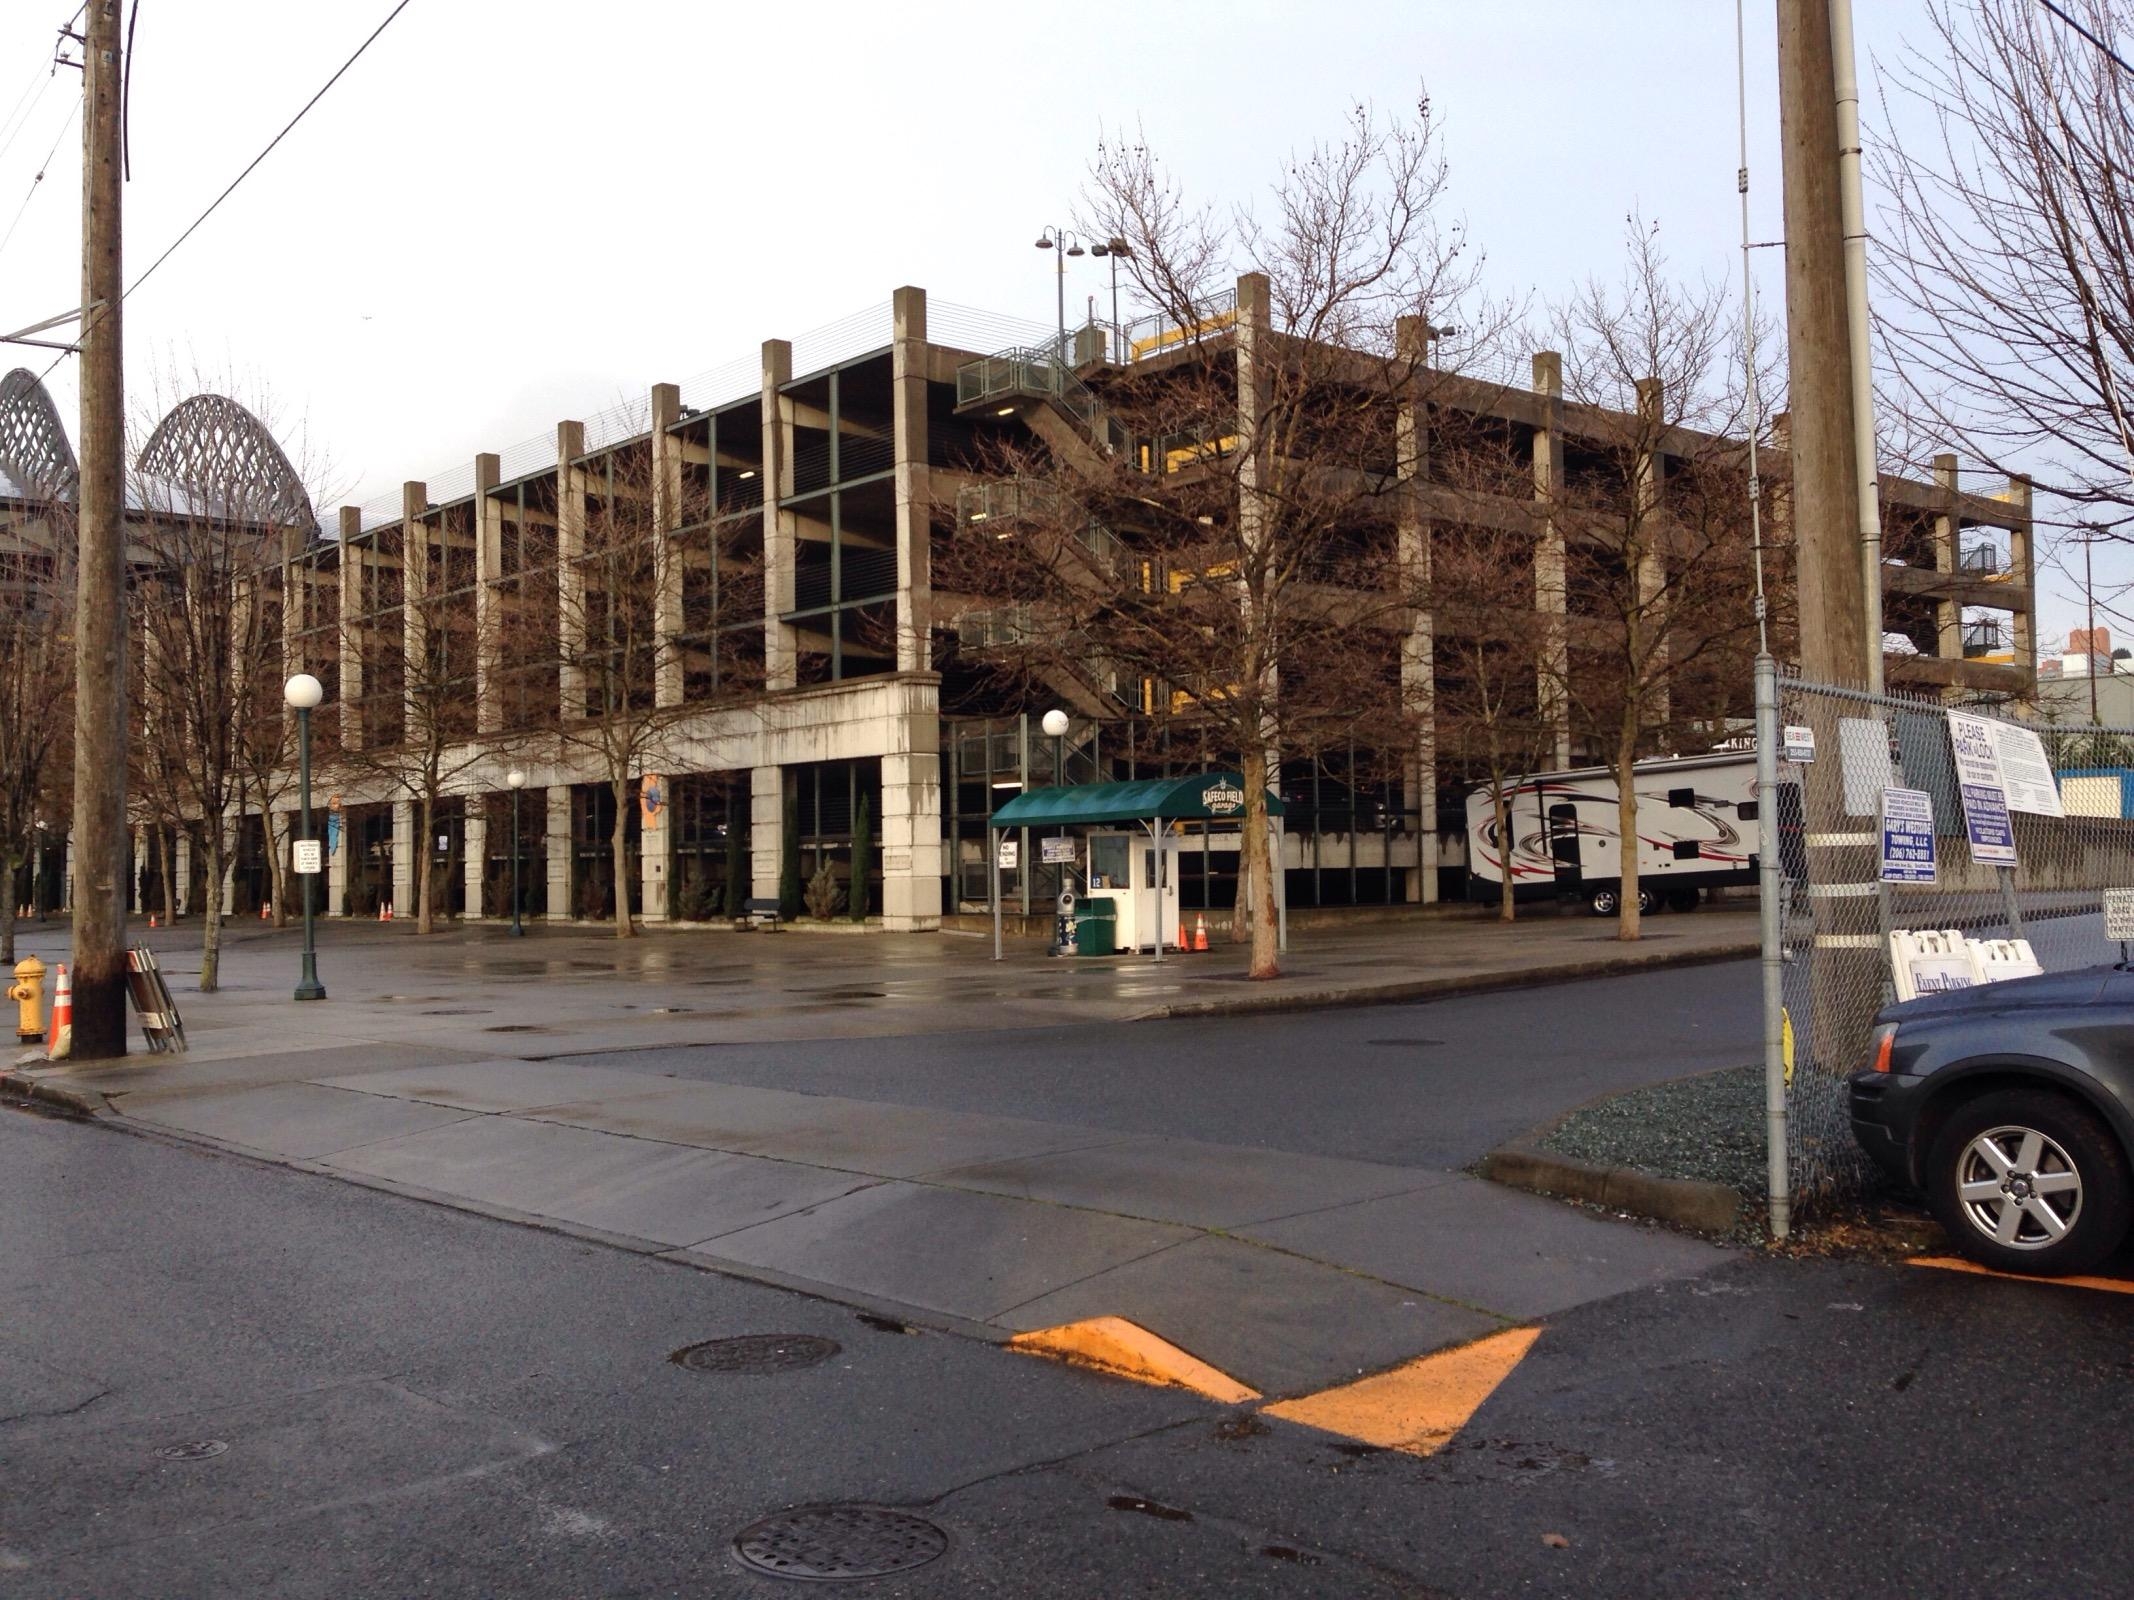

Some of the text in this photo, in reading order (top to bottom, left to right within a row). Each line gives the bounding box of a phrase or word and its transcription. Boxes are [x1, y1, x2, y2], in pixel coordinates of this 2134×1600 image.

[1958, 722, 1986, 741] PLEASE
[1956, 737, 1974, 756] PARK
[1976, 743, 1996, 760] LOCK
[1203, 790, 1244, 806] SAFECO FIELD
[1212, 802, 1236, 815] garage
[1886, 818, 1932, 836] GARY'S WESTSIDE
[1891, 834, 1915, 848] TOWING,
[1889, 847, 1905, 860] (206)
[1092, 877, 1101, 888] 12
